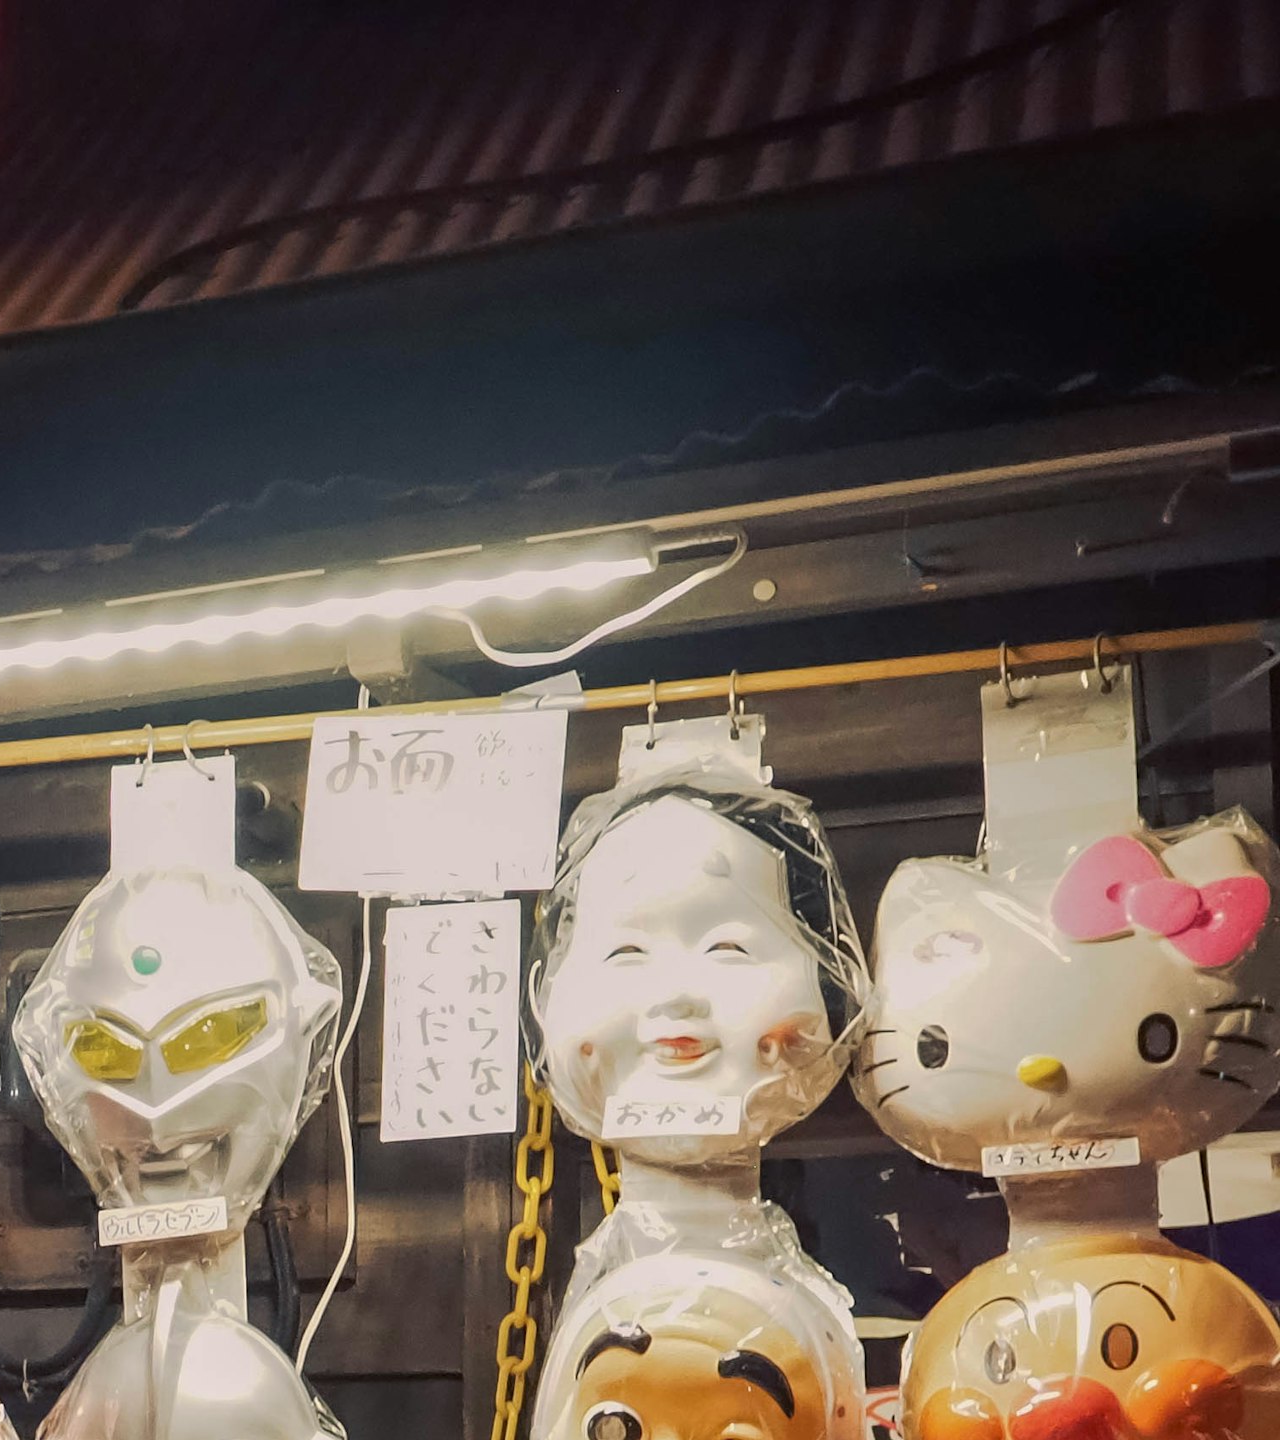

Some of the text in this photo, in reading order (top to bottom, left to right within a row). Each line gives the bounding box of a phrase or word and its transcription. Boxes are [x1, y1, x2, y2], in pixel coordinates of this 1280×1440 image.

[324, 729, 454, 794] お面
[415, 919, 456, 1129] でください
[467, 919, 508, 1122] さわらない
[615, 1103, 726, 1128] おかめ
[106, 1207, 216, 1239] ウルトラセブン
